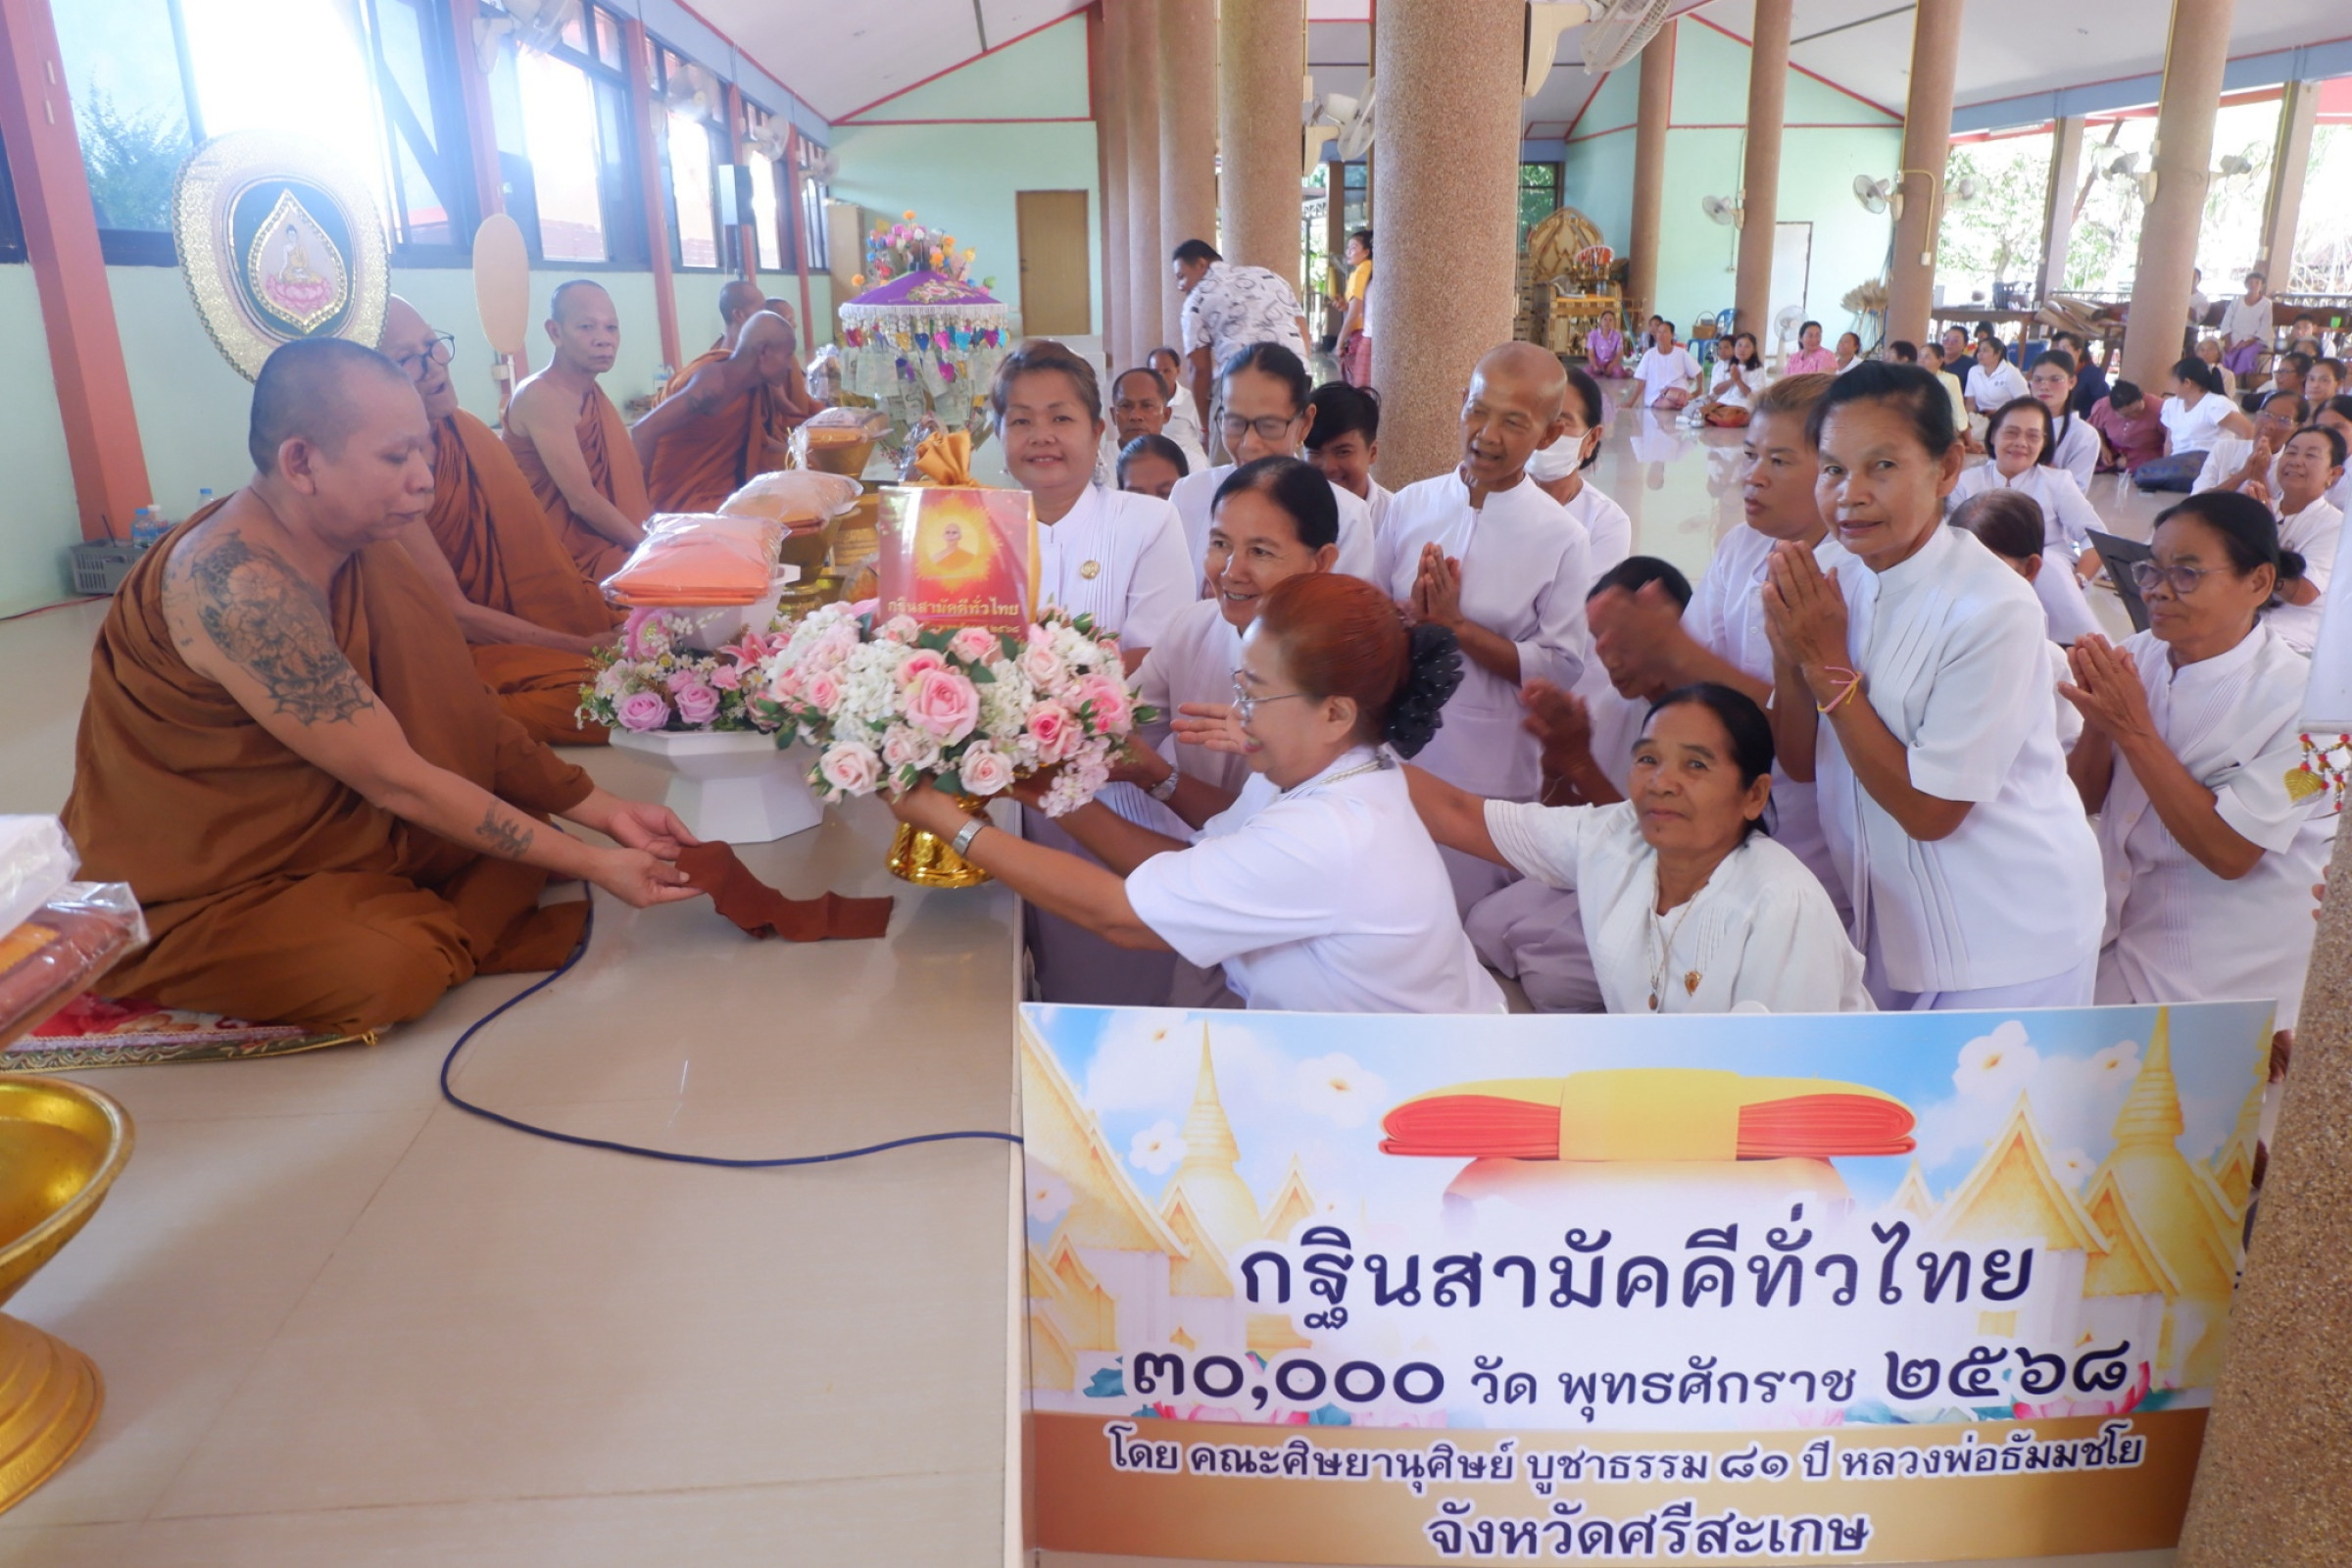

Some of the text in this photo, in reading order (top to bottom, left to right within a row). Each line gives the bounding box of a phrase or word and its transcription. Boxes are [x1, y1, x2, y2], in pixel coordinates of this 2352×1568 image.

[1240, 1201, 2034, 1331] กฐินสามัคคีทั่วไทย
[1133, 1339, 2132, 1424] ๓๐,๐๐๐ วัด พุทธศักราช ๒๕๖๘
[1106, 1416, 2144, 1495] โดย คณะศิษยานุศิษย์ บูชาธรรม ๘๑ ปี หลวงพ่อธัมมชโย
[1427, 1500, 1870, 1555] จังหวัดศรีสะเกษ
